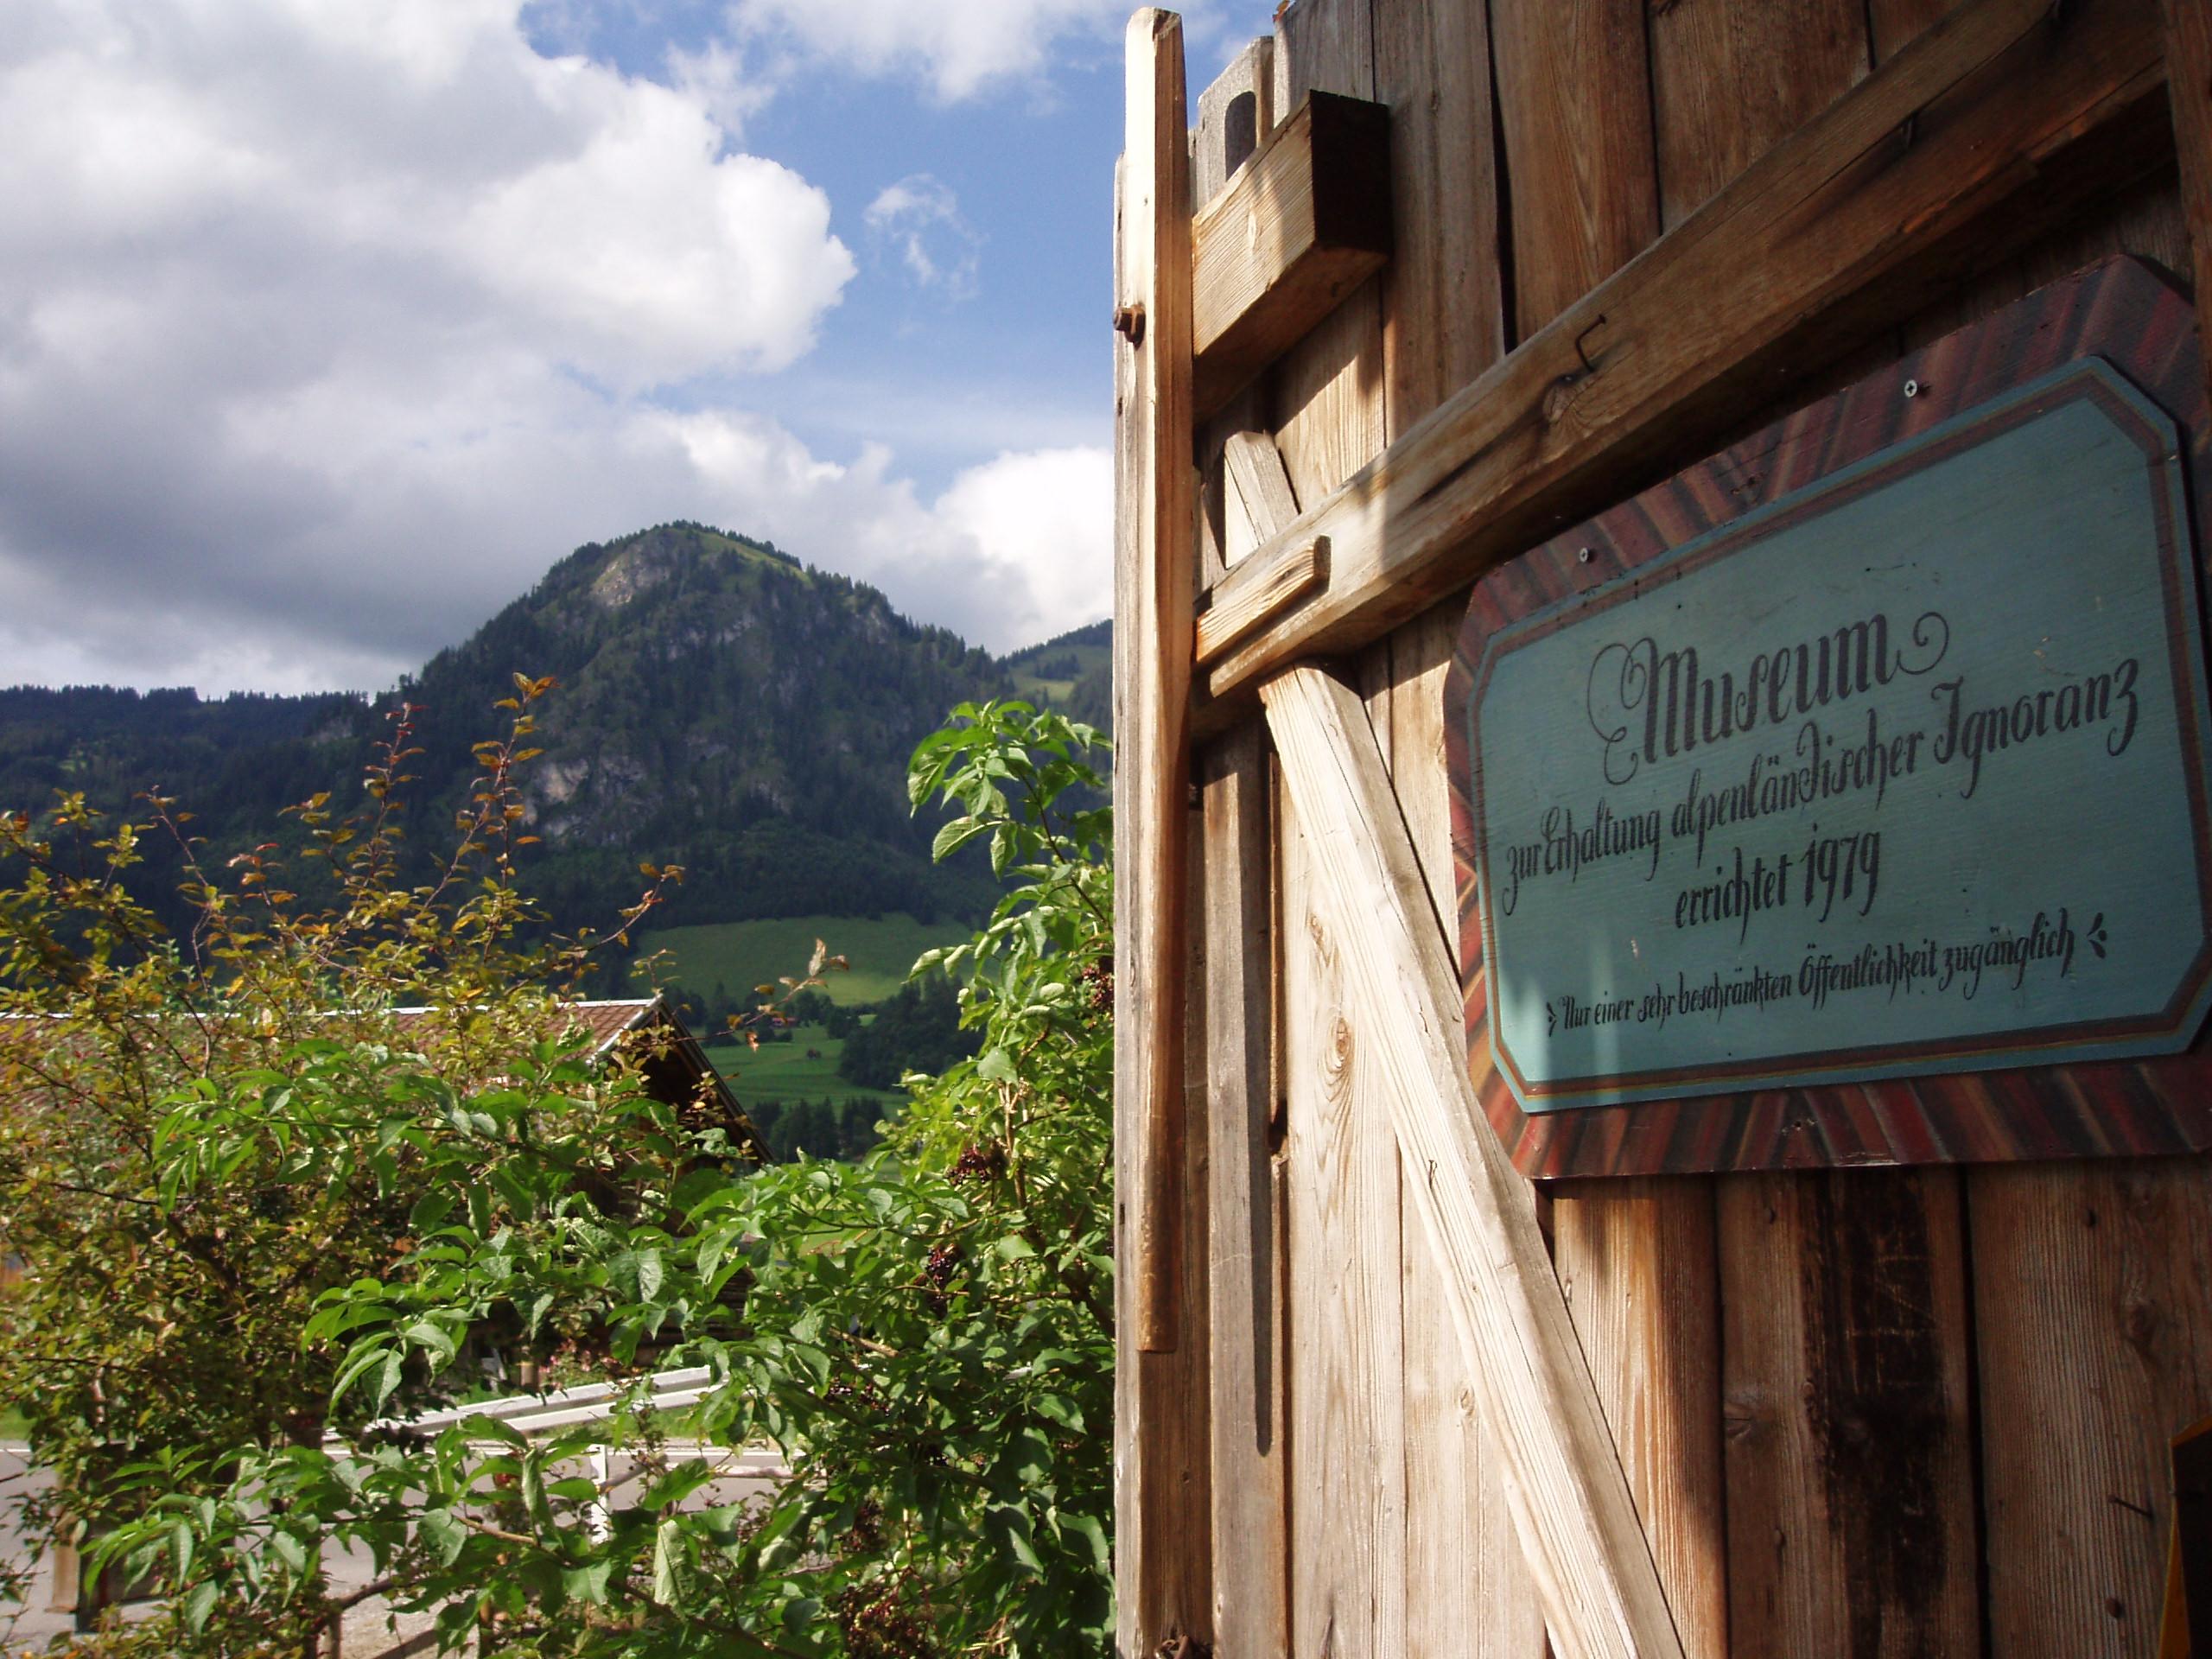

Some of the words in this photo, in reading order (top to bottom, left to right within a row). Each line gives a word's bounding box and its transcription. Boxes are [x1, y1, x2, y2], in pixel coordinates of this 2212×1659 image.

[1588, 612, 1949, 785] Museum
[1503, 843, 1542, 916] zur
[1541, 798, 1661, 882] Erhaltung
[1671, 709, 1924, 868] alpenländischer
[1933, 658, 2139, 799] Ignoranz
[1675, 848, 1792, 944] errichtet
[1800, 823, 1881, 923] 1979
[1559, 995, 1591, 1030] Nur
[1593, 990, 1635, 1026] einer
[1637, 983, 1675, 1032] sehr
[1678, 965, 1792, 1024] beschränkten
[1797, 938, 1938, 1010] Öffentlichkeit
[1938, 907, 2075, 1001] zugänglich
